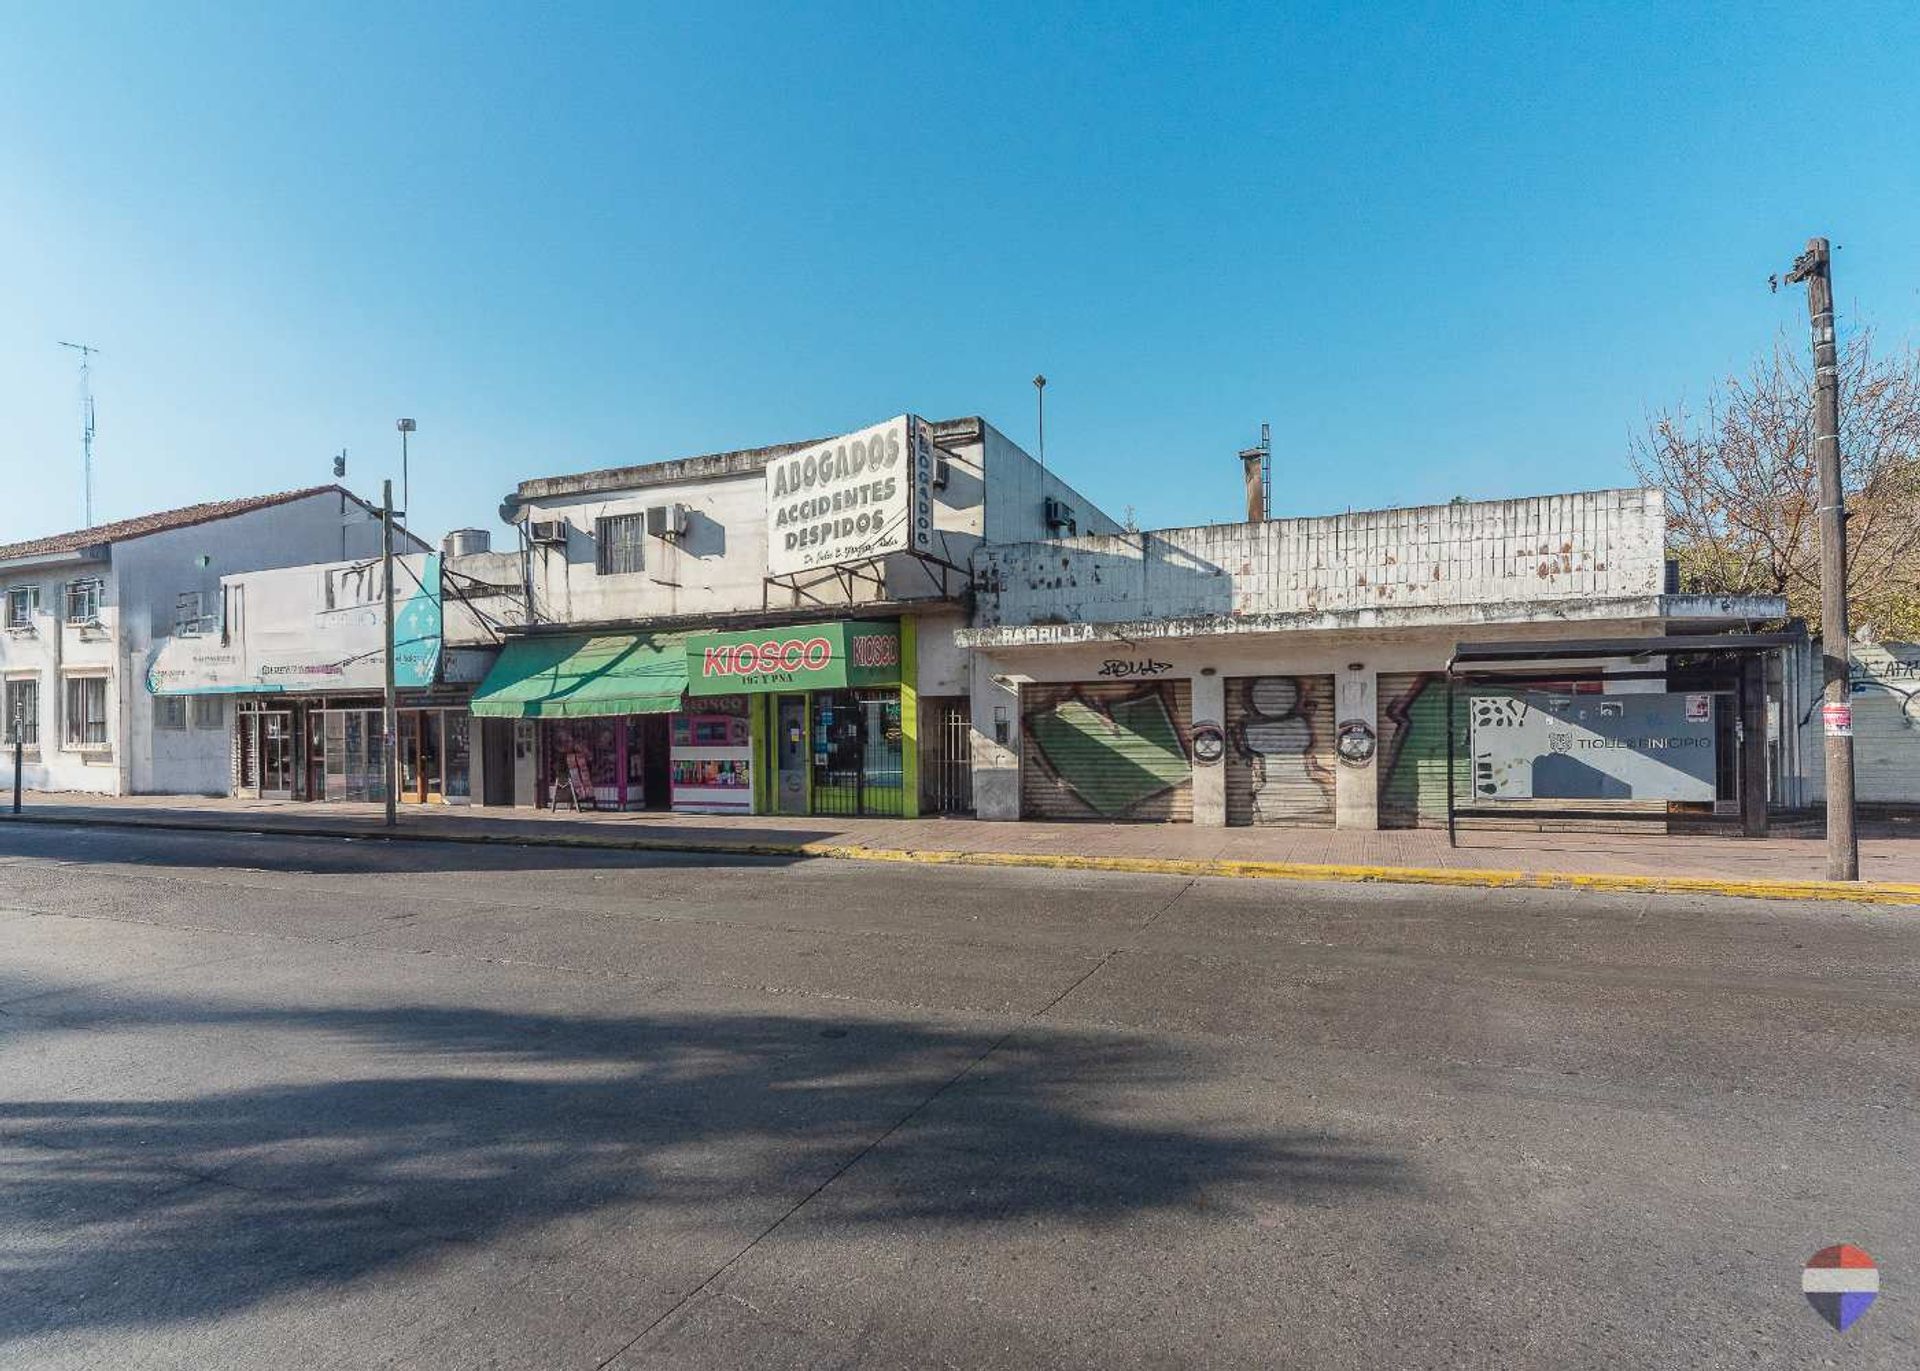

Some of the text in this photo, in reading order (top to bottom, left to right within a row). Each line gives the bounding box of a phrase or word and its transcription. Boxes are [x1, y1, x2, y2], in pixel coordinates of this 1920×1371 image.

[776, 477, 897, 527] ACCIDENTES
[785, 509, 885, 550] DESPIDOS
[703, 637, 833, 677] KIOSCO
